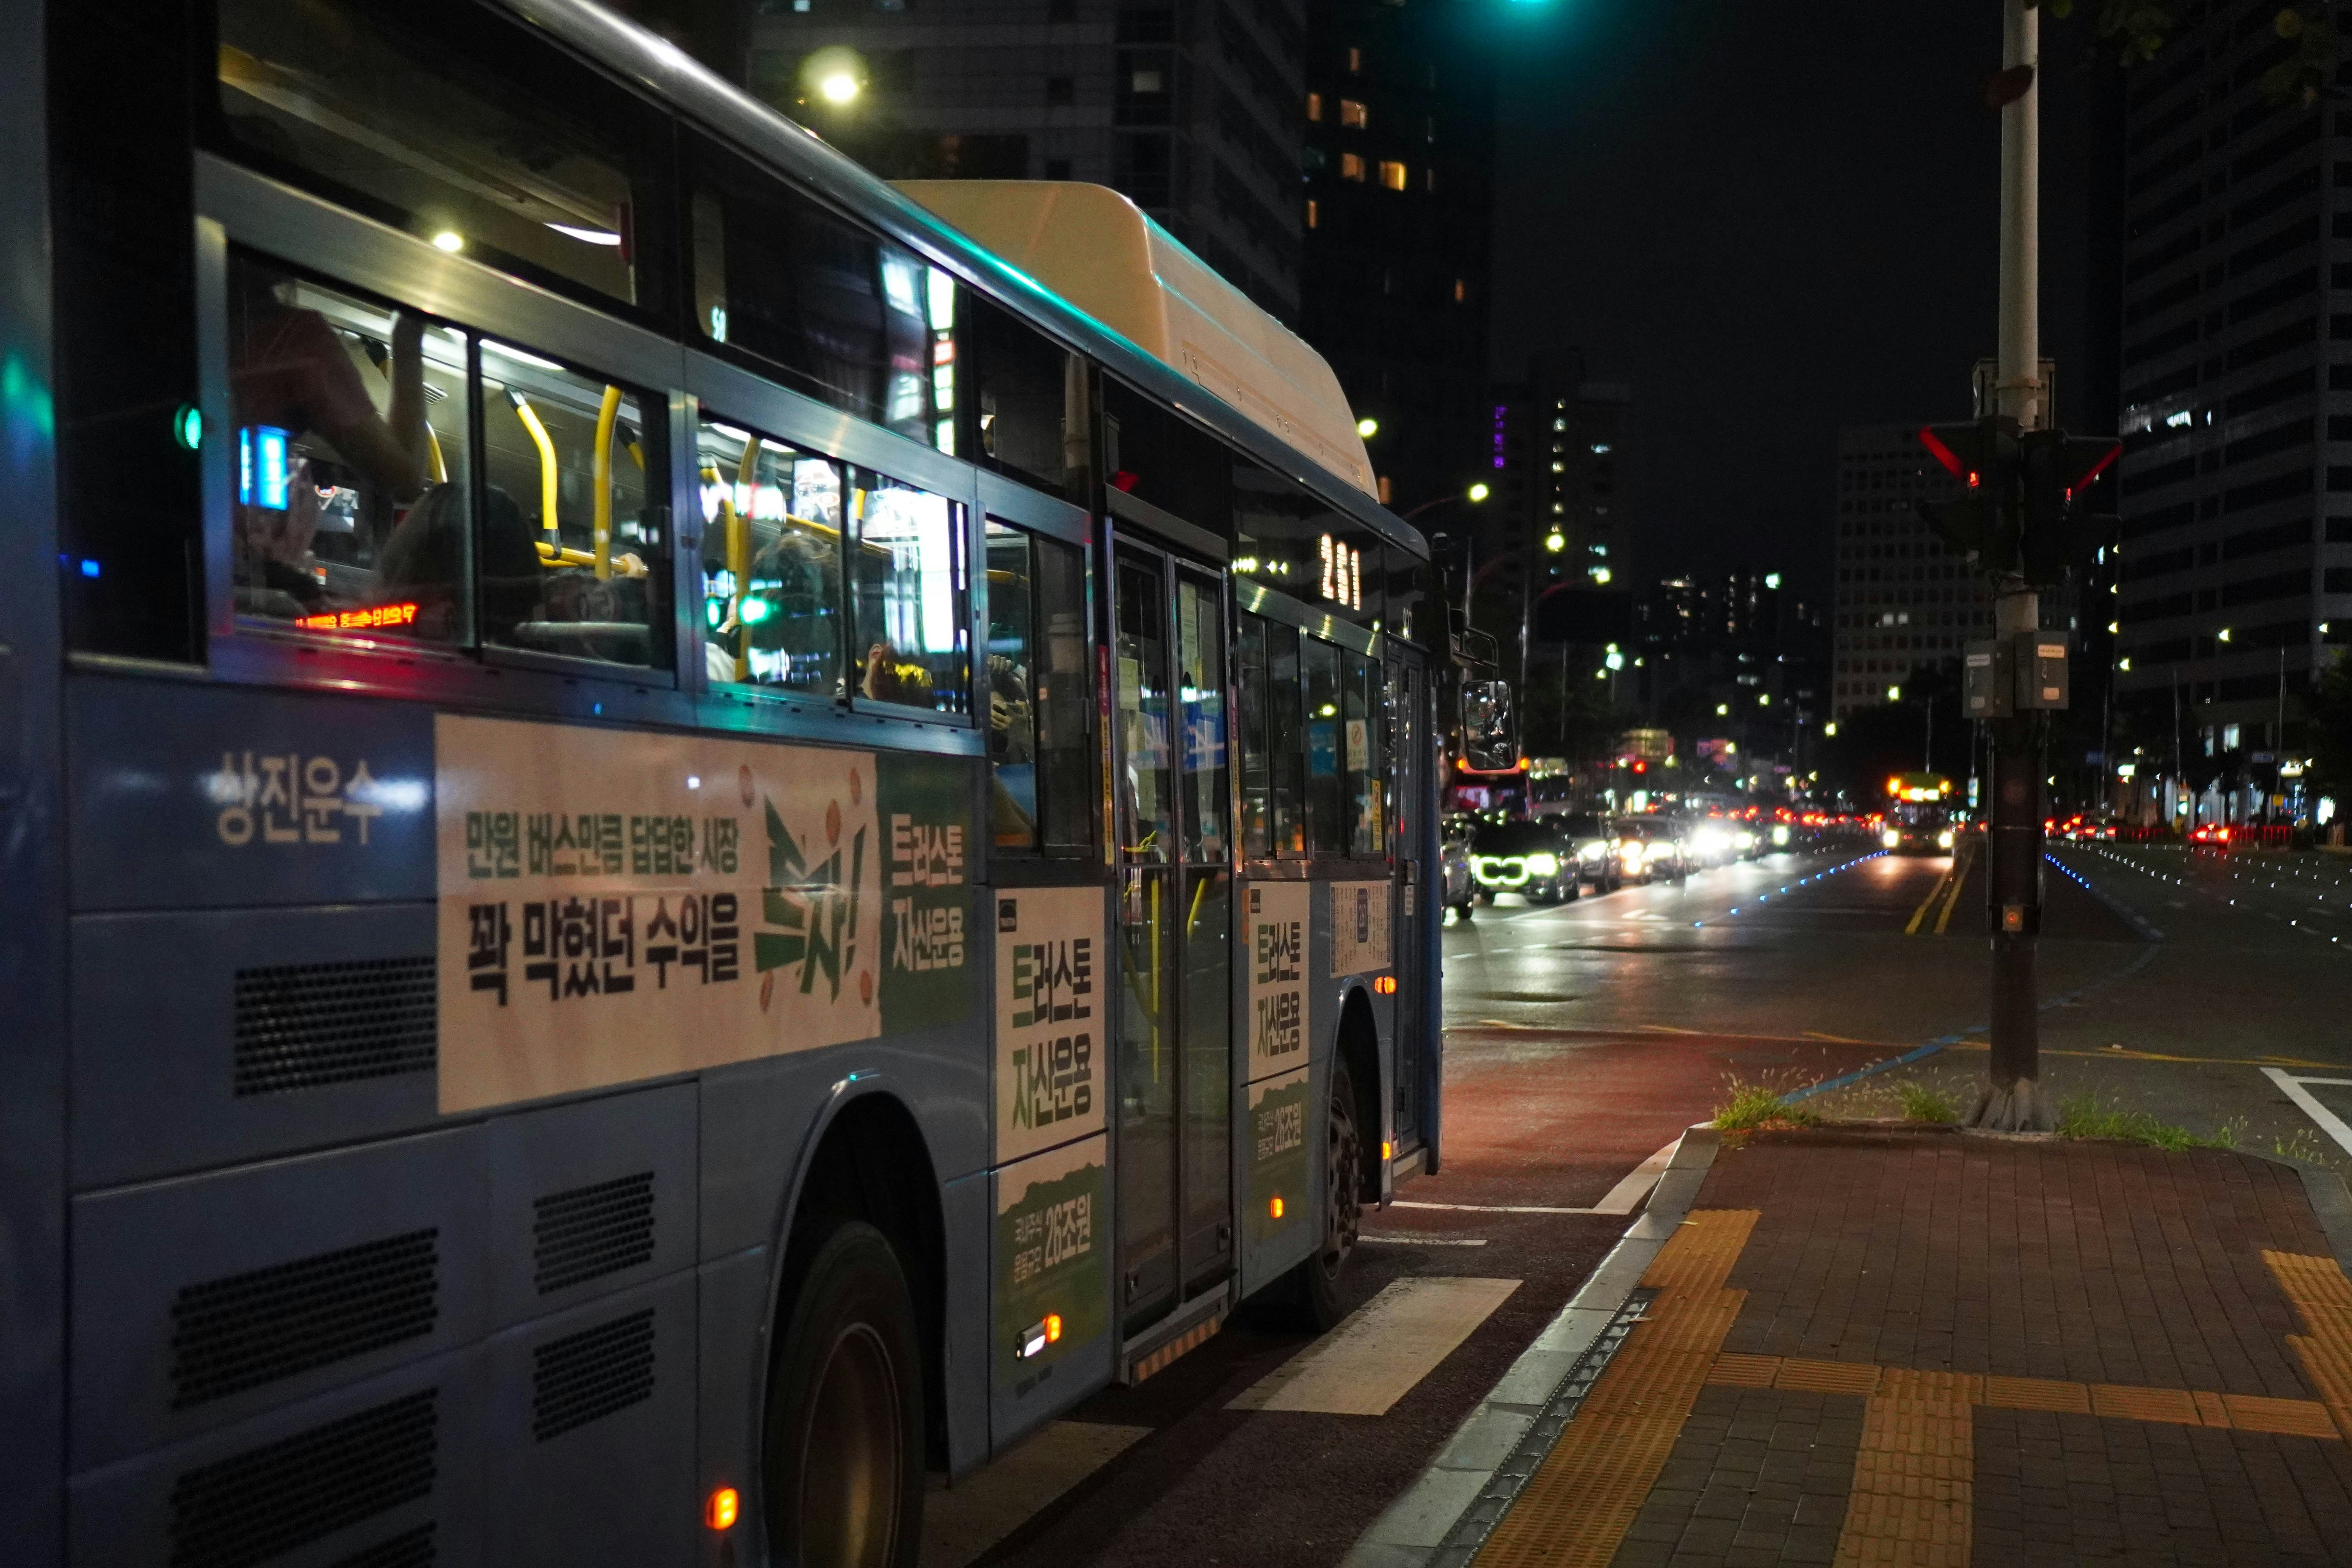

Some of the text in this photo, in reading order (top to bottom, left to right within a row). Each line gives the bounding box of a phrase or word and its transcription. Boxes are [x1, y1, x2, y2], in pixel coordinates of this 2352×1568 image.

[1321, 534, 1360, 611] 261
[466, 811, 739, 878] 만원 버스만큼 답답한 시장
[891, 813, 963, 887] 트러스톤
[468, 892, 739, 1007] 꽉 막혔던 수익을
[891, 896, 964, 971] 자산운용
[1258, 922, 1300, 984] 트러스톤
[1013, 938, 1091, 1029] 트러스톤
[1258, 991, 1300, 1057] 자산운용
[1013, 1033, 1091, 1130] 자산운용
[1274, 1101, 1301, 1152] 26조원
[1044, 1192, 1091, 1267] 26조원
